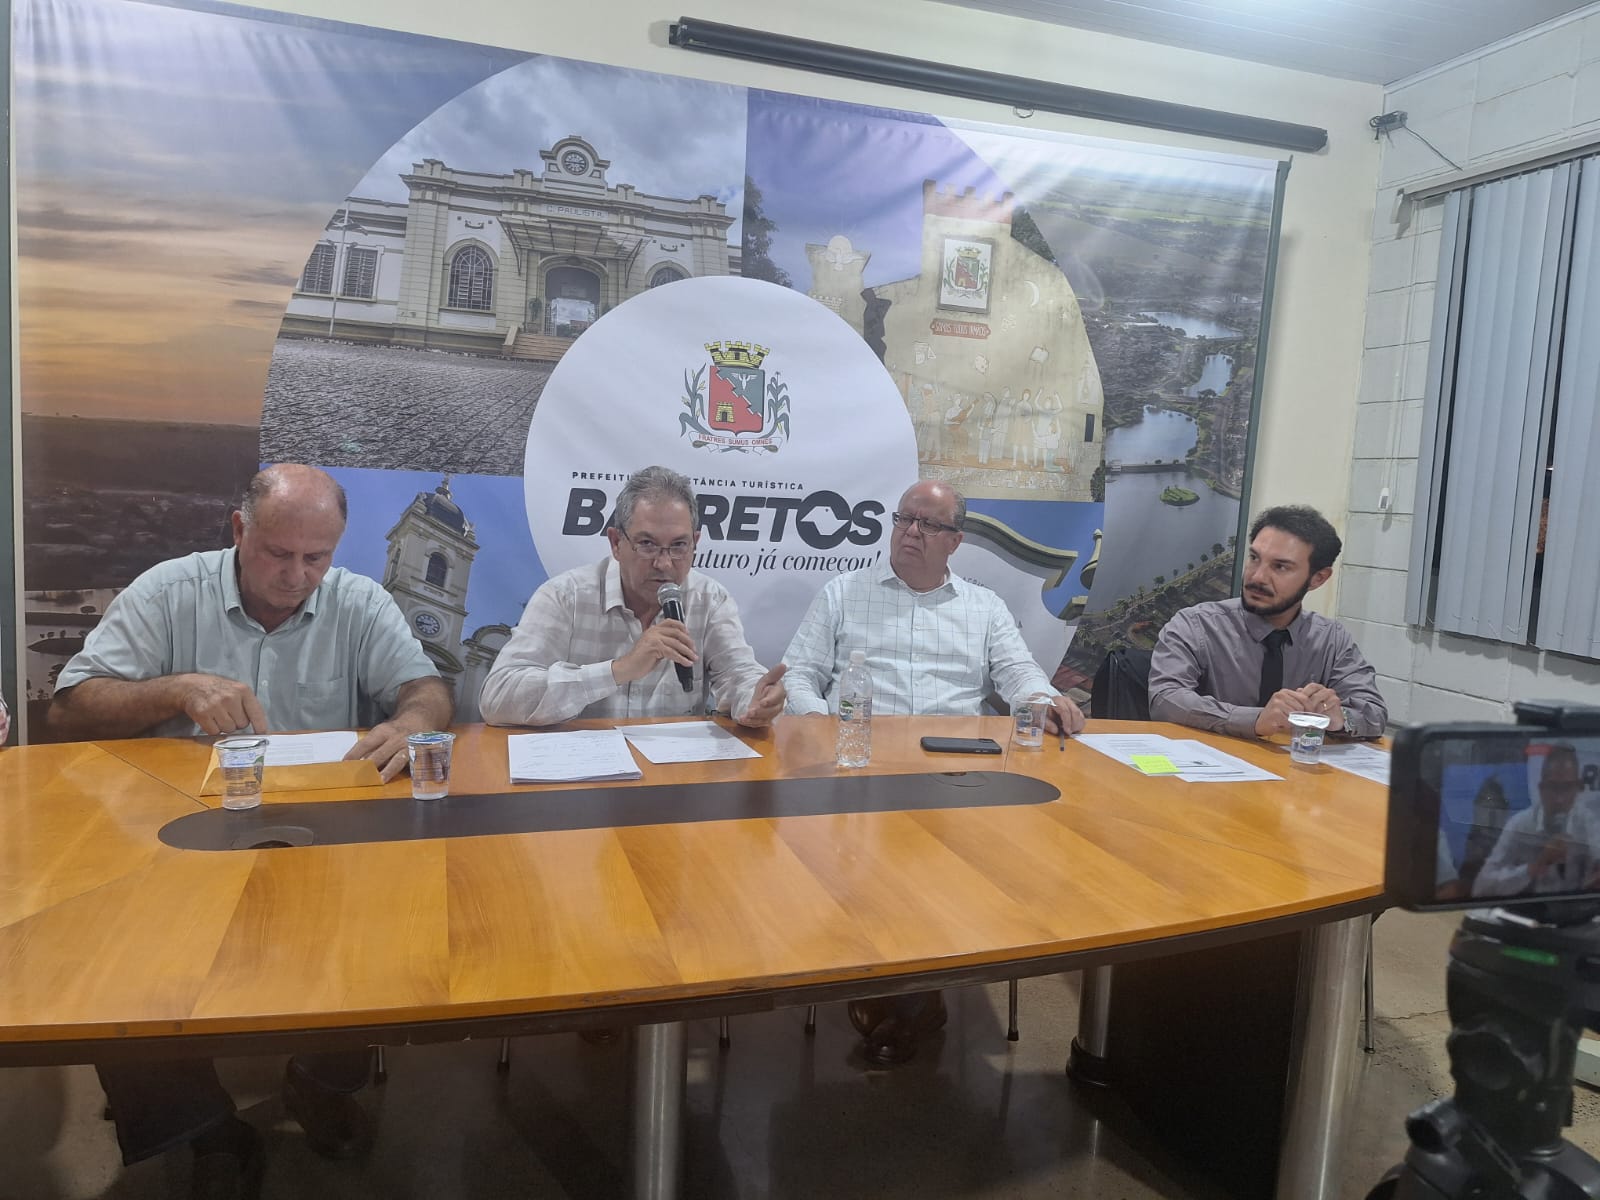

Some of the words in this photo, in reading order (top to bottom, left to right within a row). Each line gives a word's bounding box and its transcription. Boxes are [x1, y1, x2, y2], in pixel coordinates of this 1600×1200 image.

[742, 479, 804, 490] TURÍSTICA
[562, 487, 886, 550] BRETOS
[750, 548, 777, 576] já
